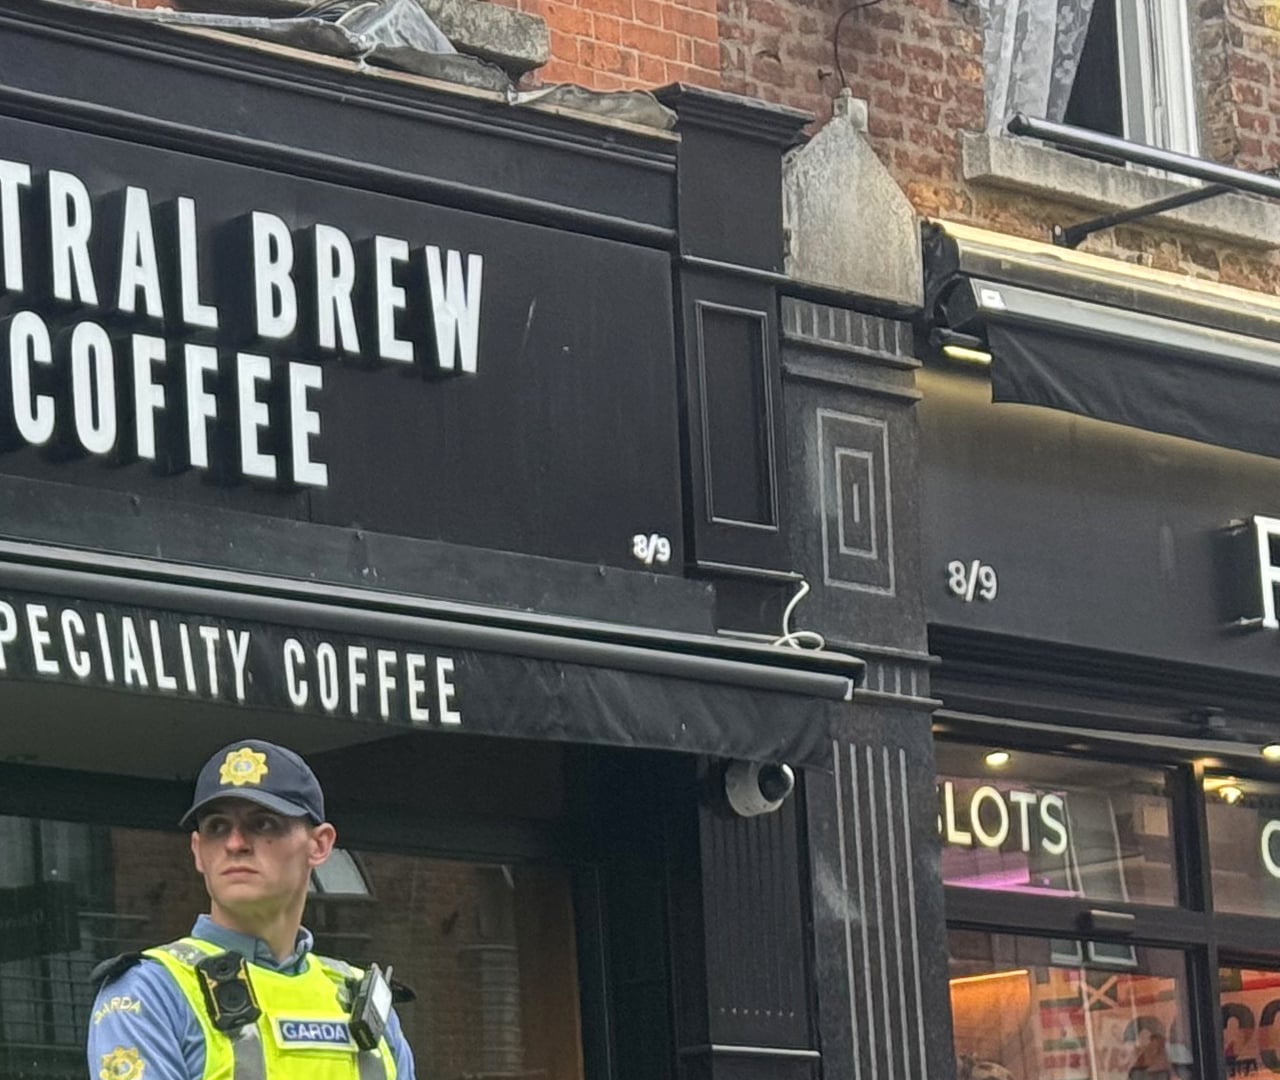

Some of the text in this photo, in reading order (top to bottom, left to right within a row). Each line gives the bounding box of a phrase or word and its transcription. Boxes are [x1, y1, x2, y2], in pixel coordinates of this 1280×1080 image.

[252, 211, 482, 375] BREW
[10, 310, 328, 487] COFFEE
[632, 533, 671, 564] 8/9
[948, 558, 997, 603] 8/9
[284, 635, 463, 727] COFFEE
[936, 779, 1068, 856] LOTS
[93, 996, 141, 1025] GARDA
[283, 1022, 348, 1041] GARDA
